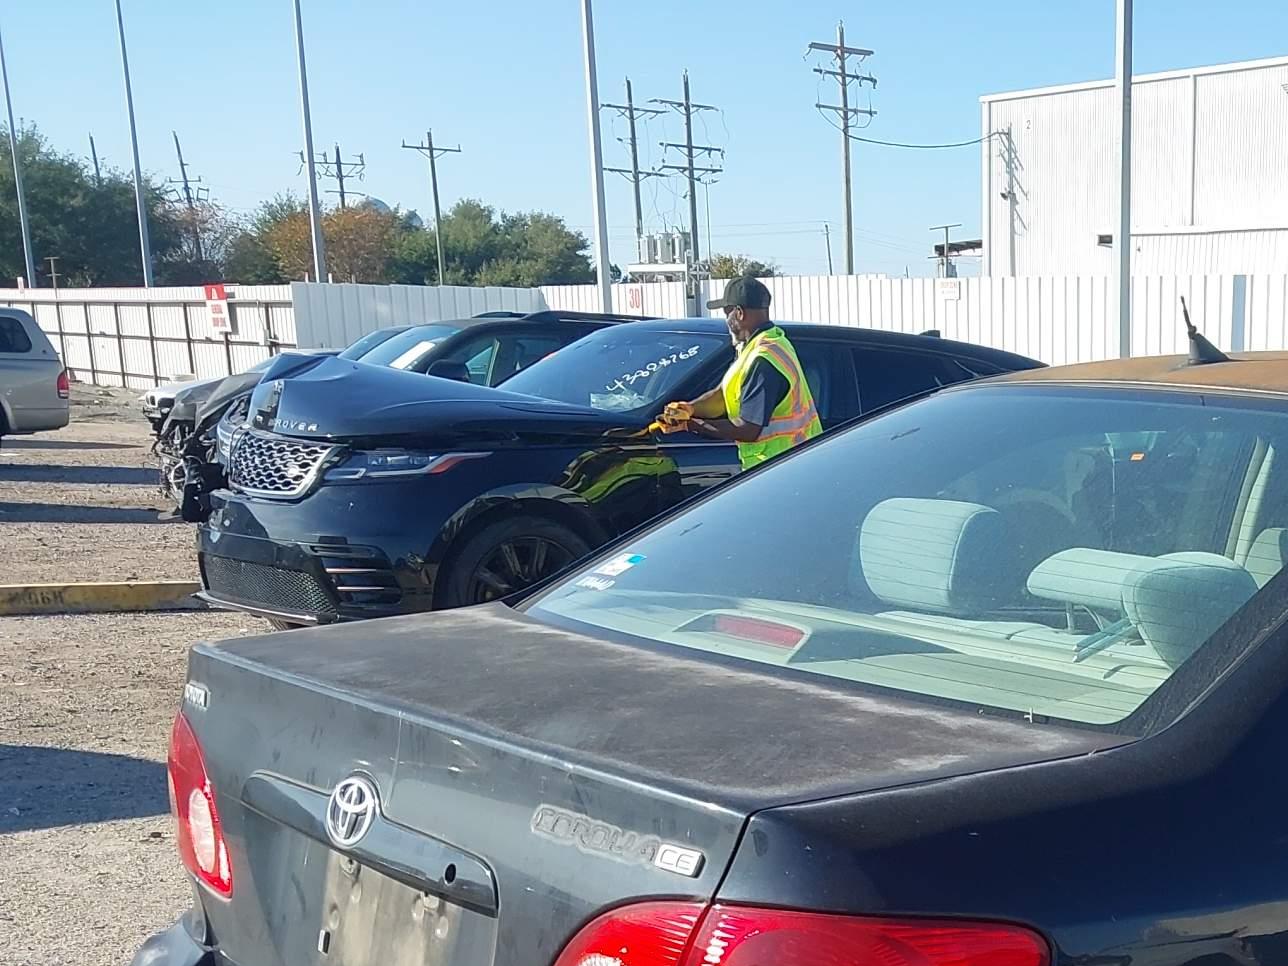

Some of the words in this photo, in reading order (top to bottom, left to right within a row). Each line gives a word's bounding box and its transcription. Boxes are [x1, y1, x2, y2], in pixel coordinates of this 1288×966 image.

[629, 287, 641, 309] 30
[274, 418, 318, 433] ROVER
[657, 846, 701, 876] CE
